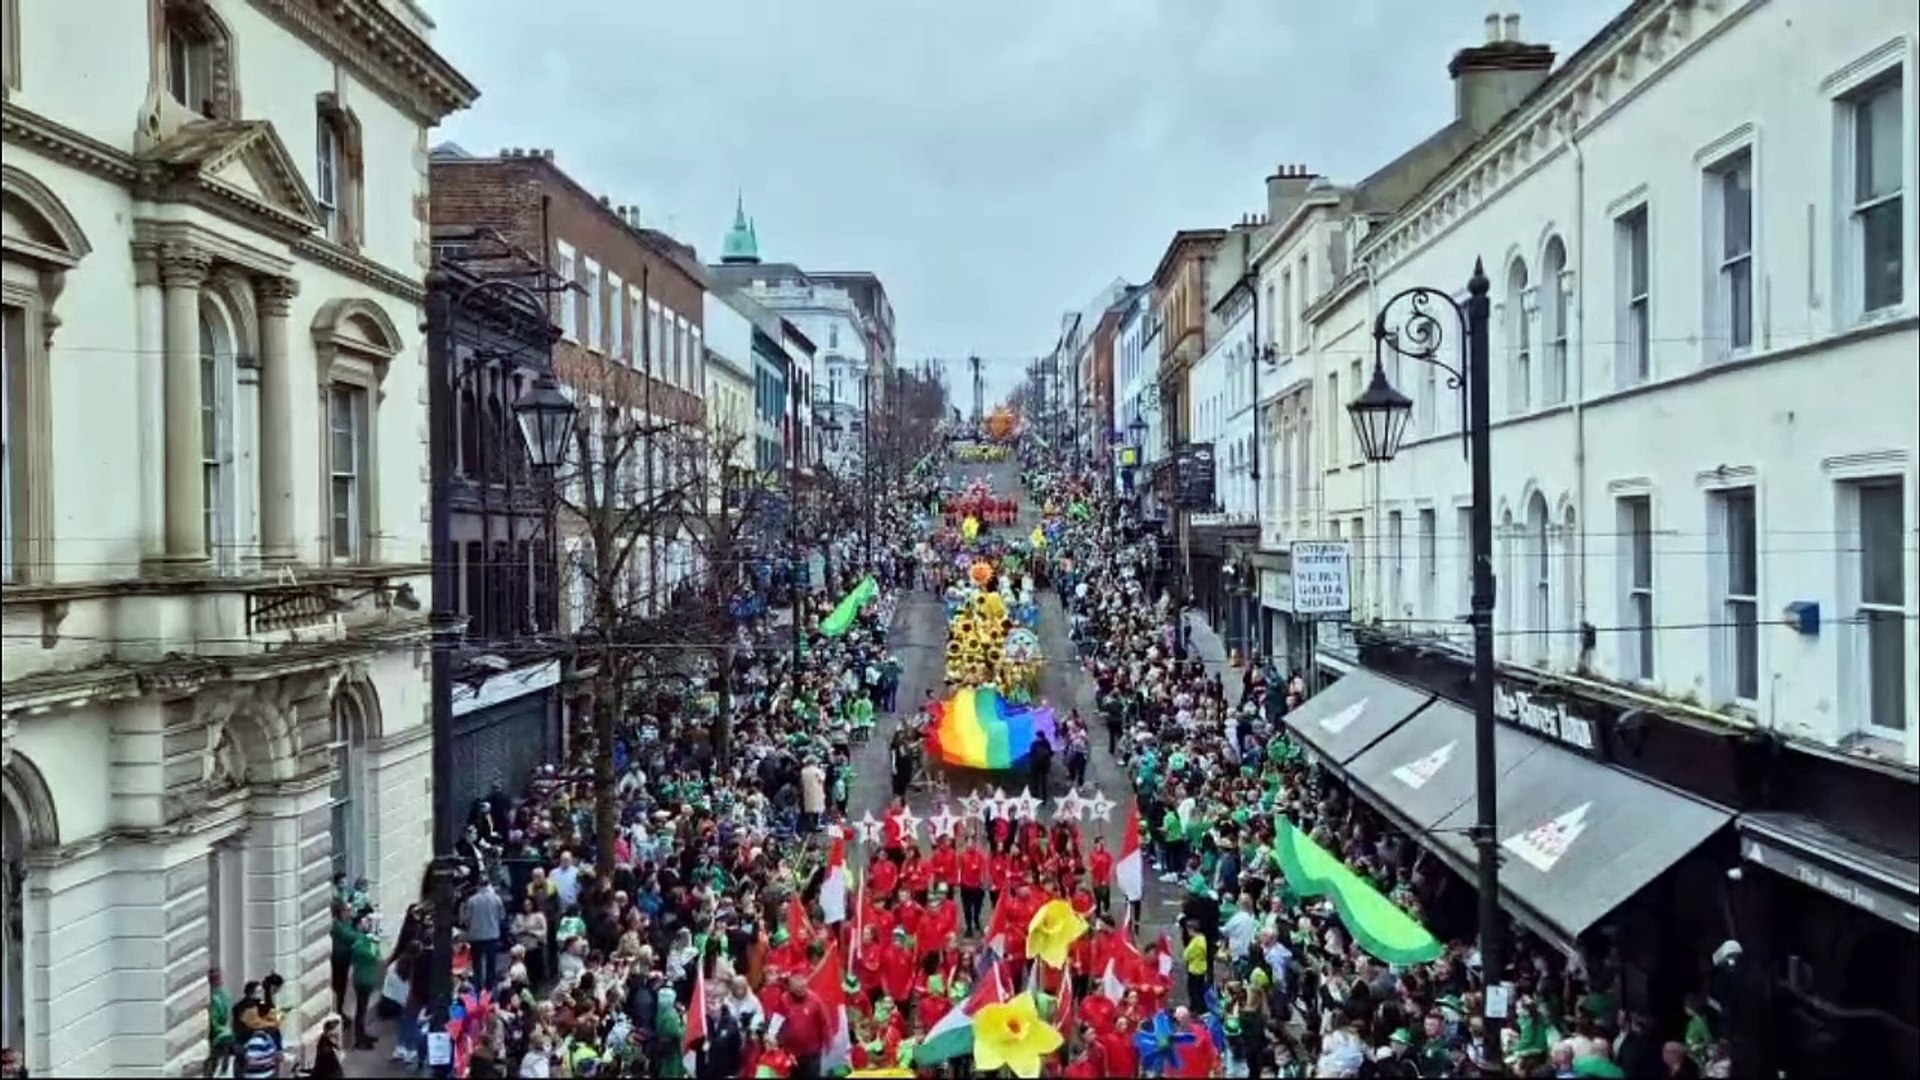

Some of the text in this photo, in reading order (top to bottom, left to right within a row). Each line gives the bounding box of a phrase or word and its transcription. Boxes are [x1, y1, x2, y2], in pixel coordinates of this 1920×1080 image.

[1297, 572, 1342, 582] WE BUY
[1299, 585, 1333, 595] GOLD
[1300, 597, 1344, 607] SILVER
